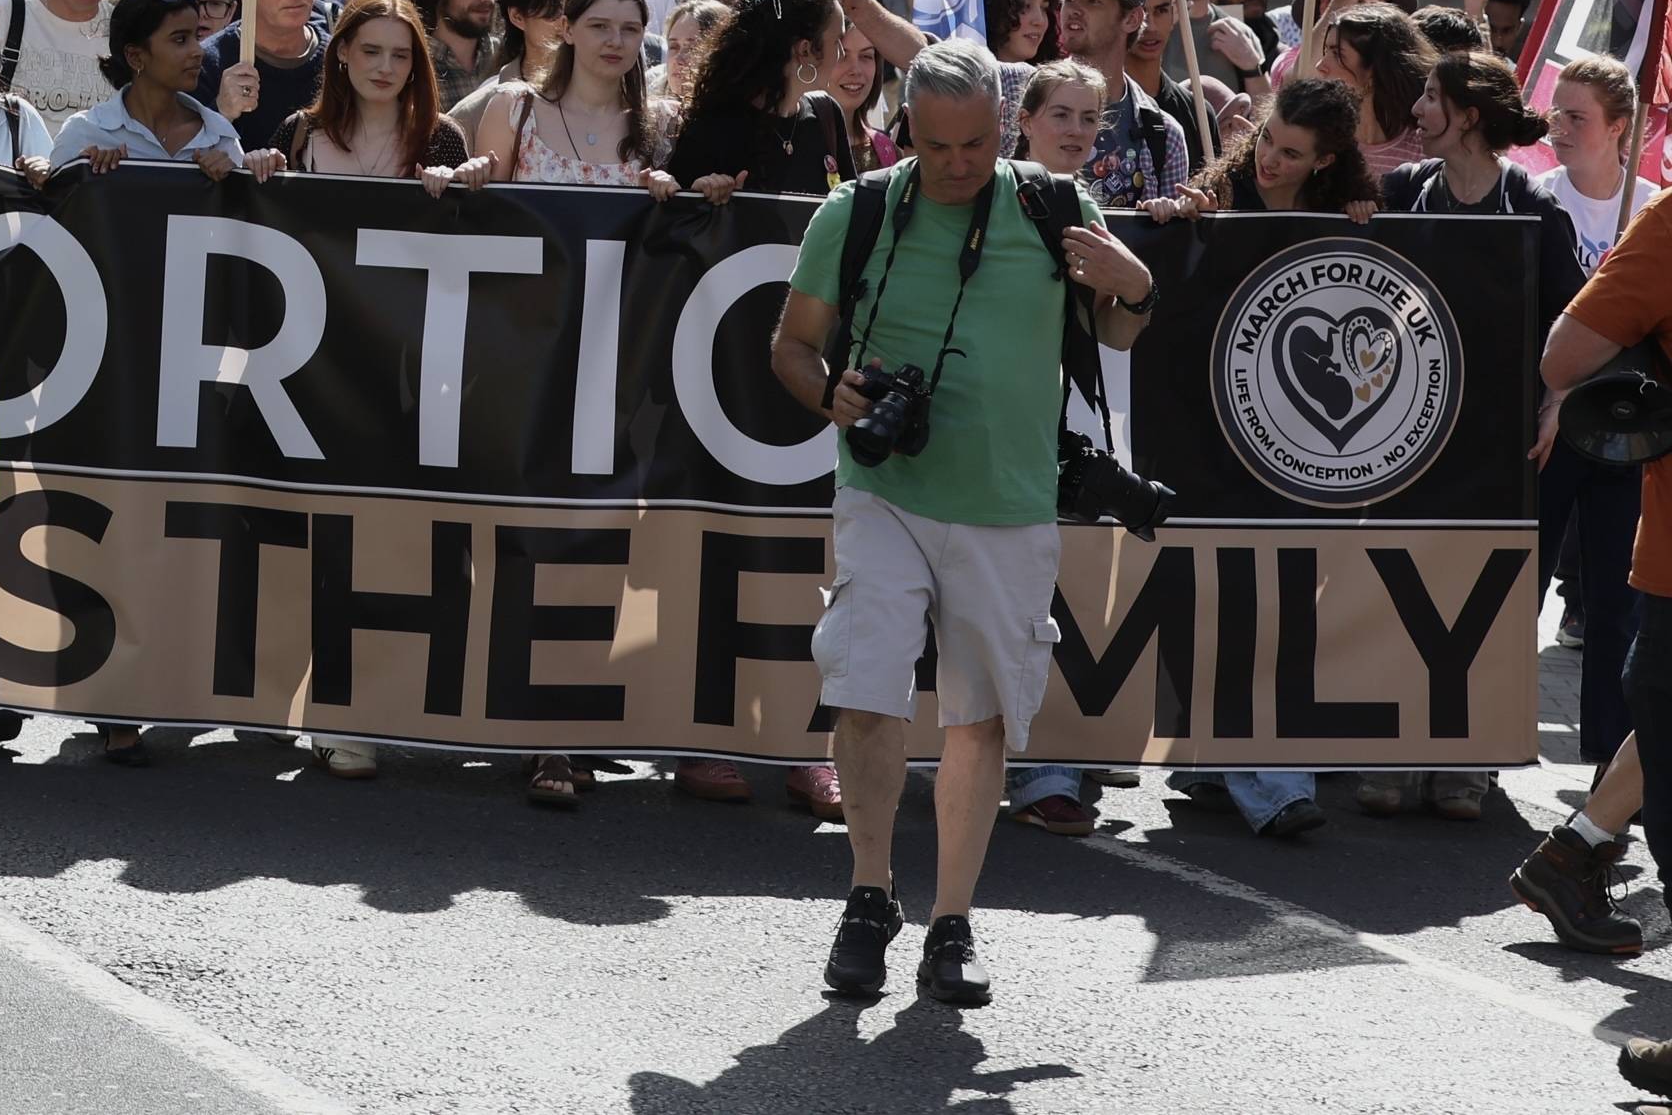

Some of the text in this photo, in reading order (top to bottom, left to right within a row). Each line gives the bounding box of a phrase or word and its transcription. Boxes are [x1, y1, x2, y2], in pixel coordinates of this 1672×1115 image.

[1236, 263, 1438, 355] MARCH FOR LIFE UK
[1234, 368, 1252, 405] LIFE
[1405, 358, 1442, 446] EXCEPTION
[1242, 405, 1275, 452] FROM
[1273, 447, 1374, 481] CONCEPTION
[1383, 444, 1407, 467] NO
[164, 500, 632, 721] THE
[693, 527, 1532, 739] FMILY
